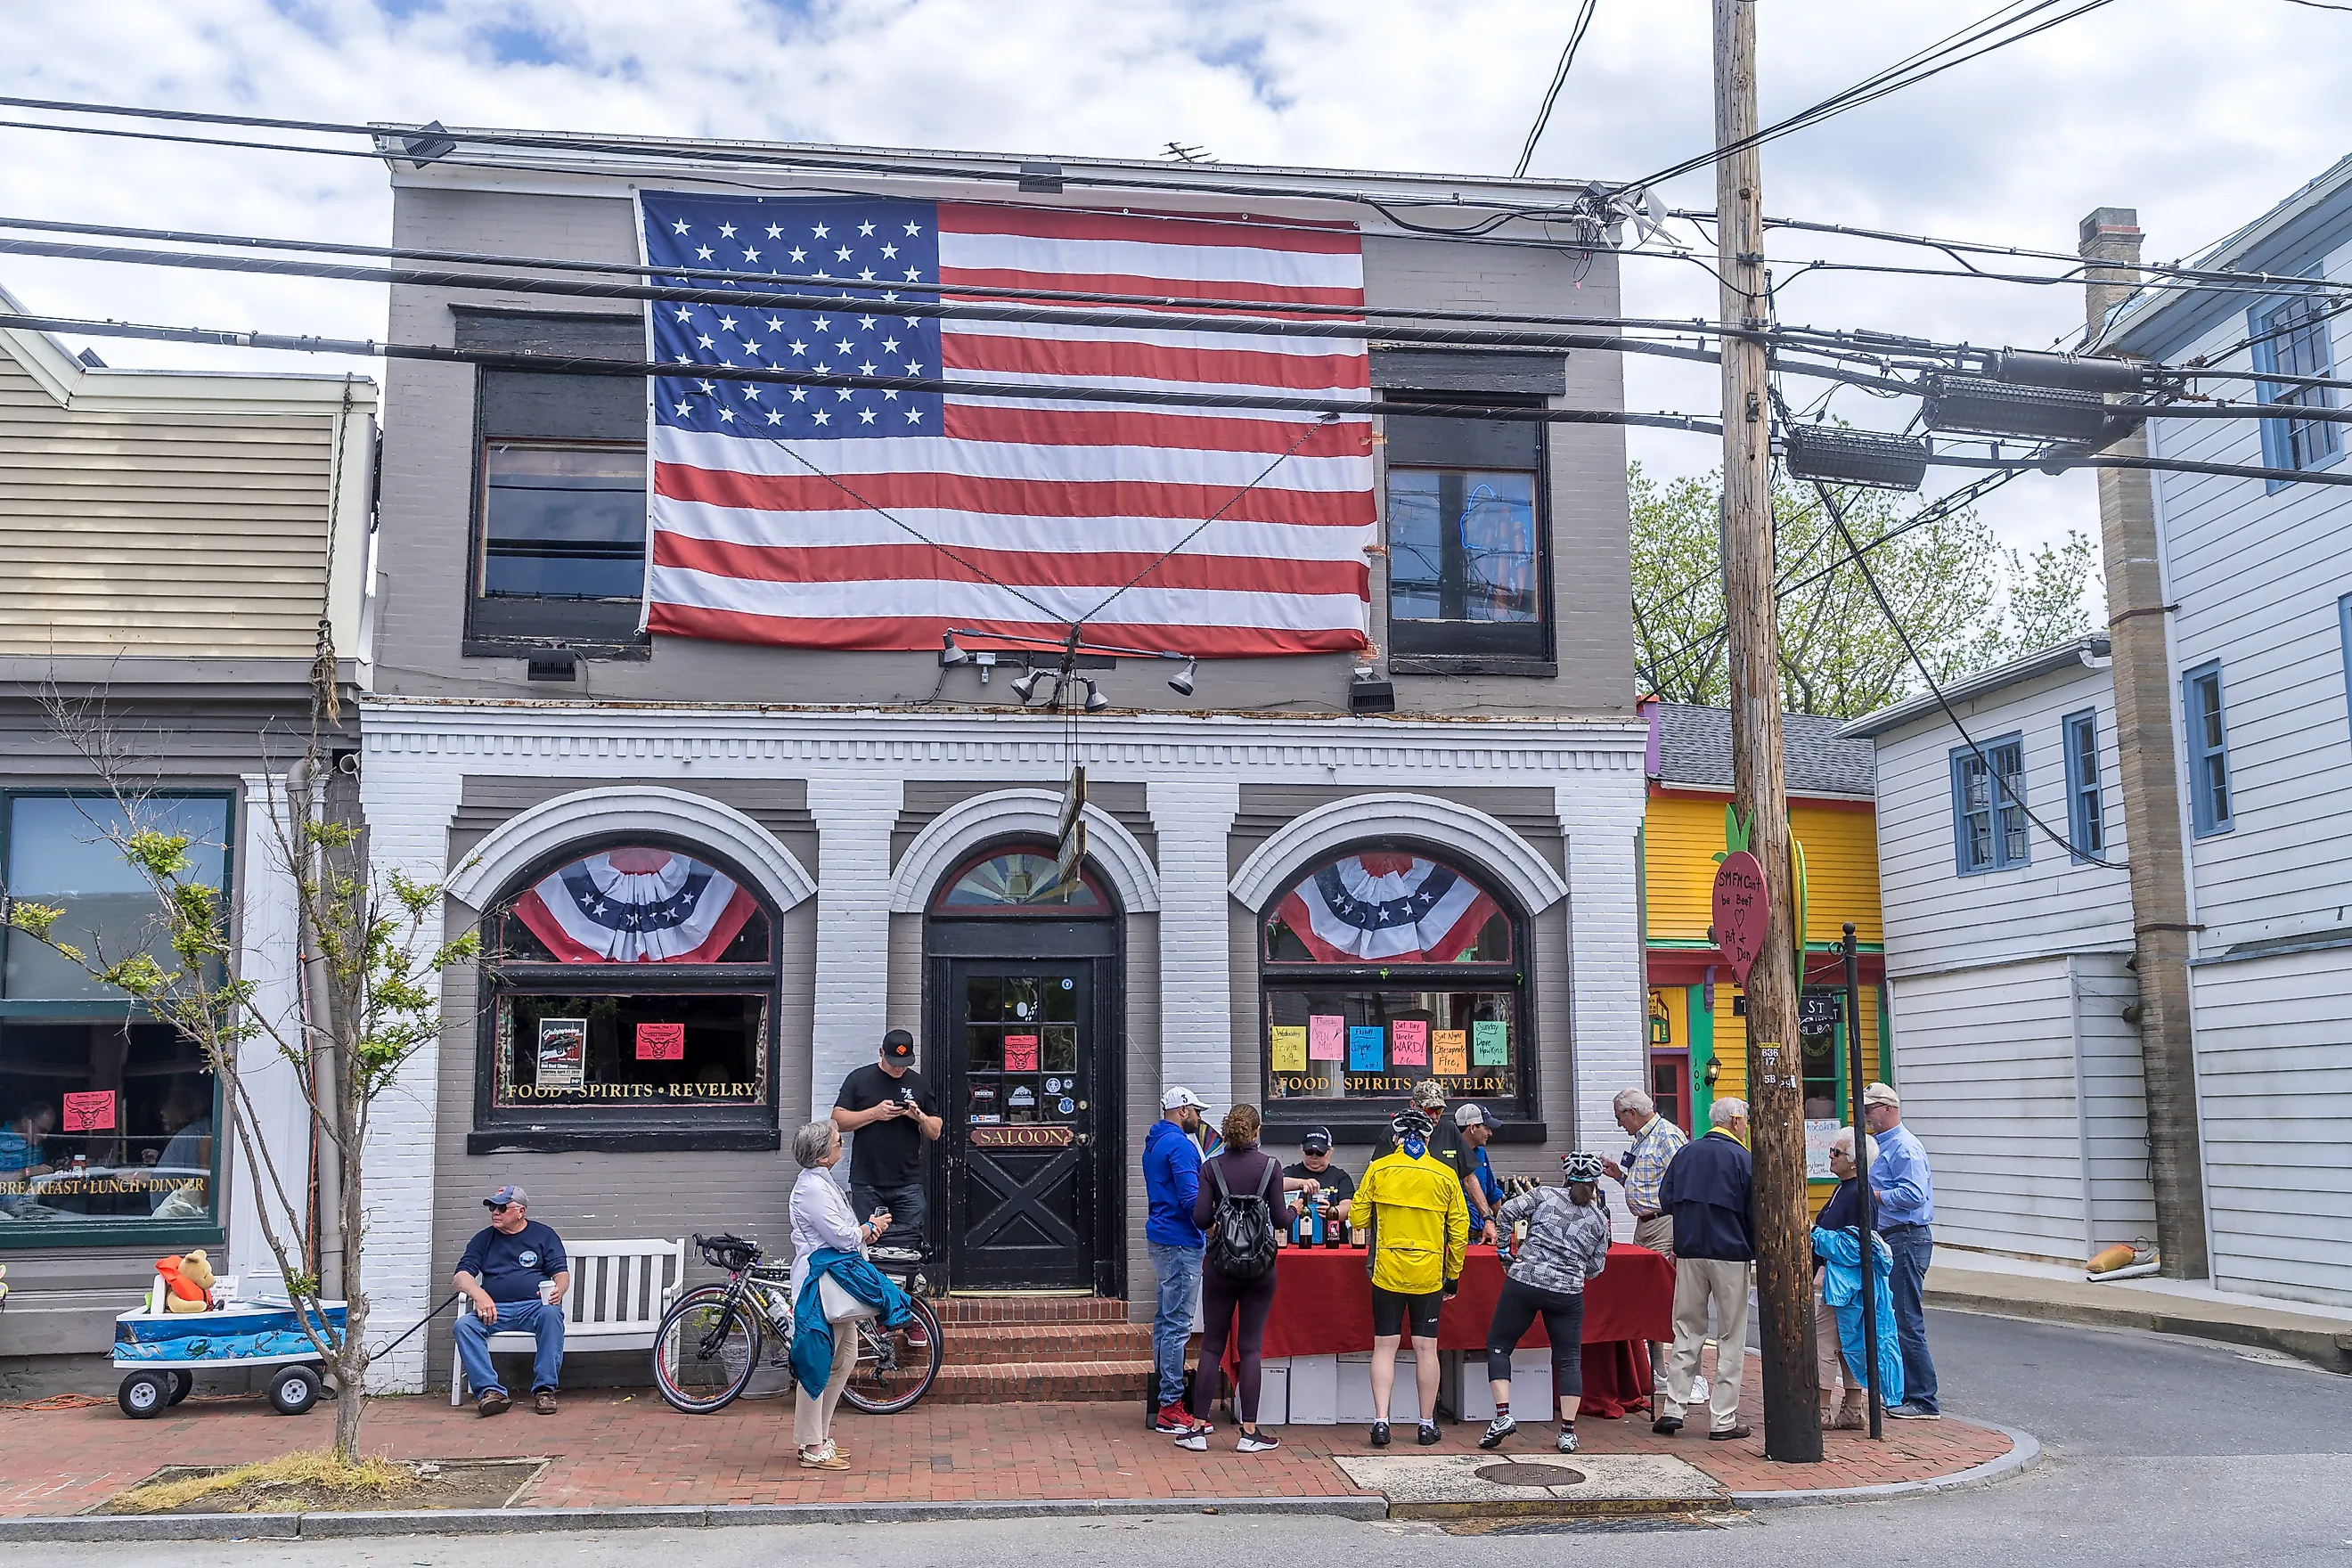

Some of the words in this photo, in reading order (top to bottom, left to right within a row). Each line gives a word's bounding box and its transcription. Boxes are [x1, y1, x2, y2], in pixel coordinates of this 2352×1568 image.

[1719, 871, 1743, 888] SMFM
[1744, 875, 1761, 892] Can't
[1721, 894, 1730, 906] be
[1735, 894, 1753, 908] Beet
[1725, 928, 1735, 944] Pat
[1736, 947, 1752, 962] Dan
[1808, 1000, 1825, 1014] ST
[1409, 1022, 1420, 1031] Day
[1475, 1023, 1499, 1034] Sunday
[1311, 1028, 1329, 1041] OPEN
[1448, 1032, 1463, 1041] Night
[1394, 1039, 1425, 1057] WARD!
[1761, 1048, 1779, 1058] 636
[1765, 1057, 1776, 1066] 17
[1279, 1076, 1329, 1090] FOOD
[1343, 1076, 1412, 1090] SPIRITS
[1764, 1074, 1776, 1084] 5B
[509, 1083, 563, 1098] FOOD
[578, 1083, 654, 1098] SPIRITS
[669, 1082, 757, 1098] REVELRY
[1180, 1094, 1188, 1104] 3
[980, 1130, 1065, 1144] SALOON
[0, 1180, 81, 1196] BREAKFAST
[89, 1179, 141, 1194] LUNCH
[149, 1177, 205, 1192] DINNER
